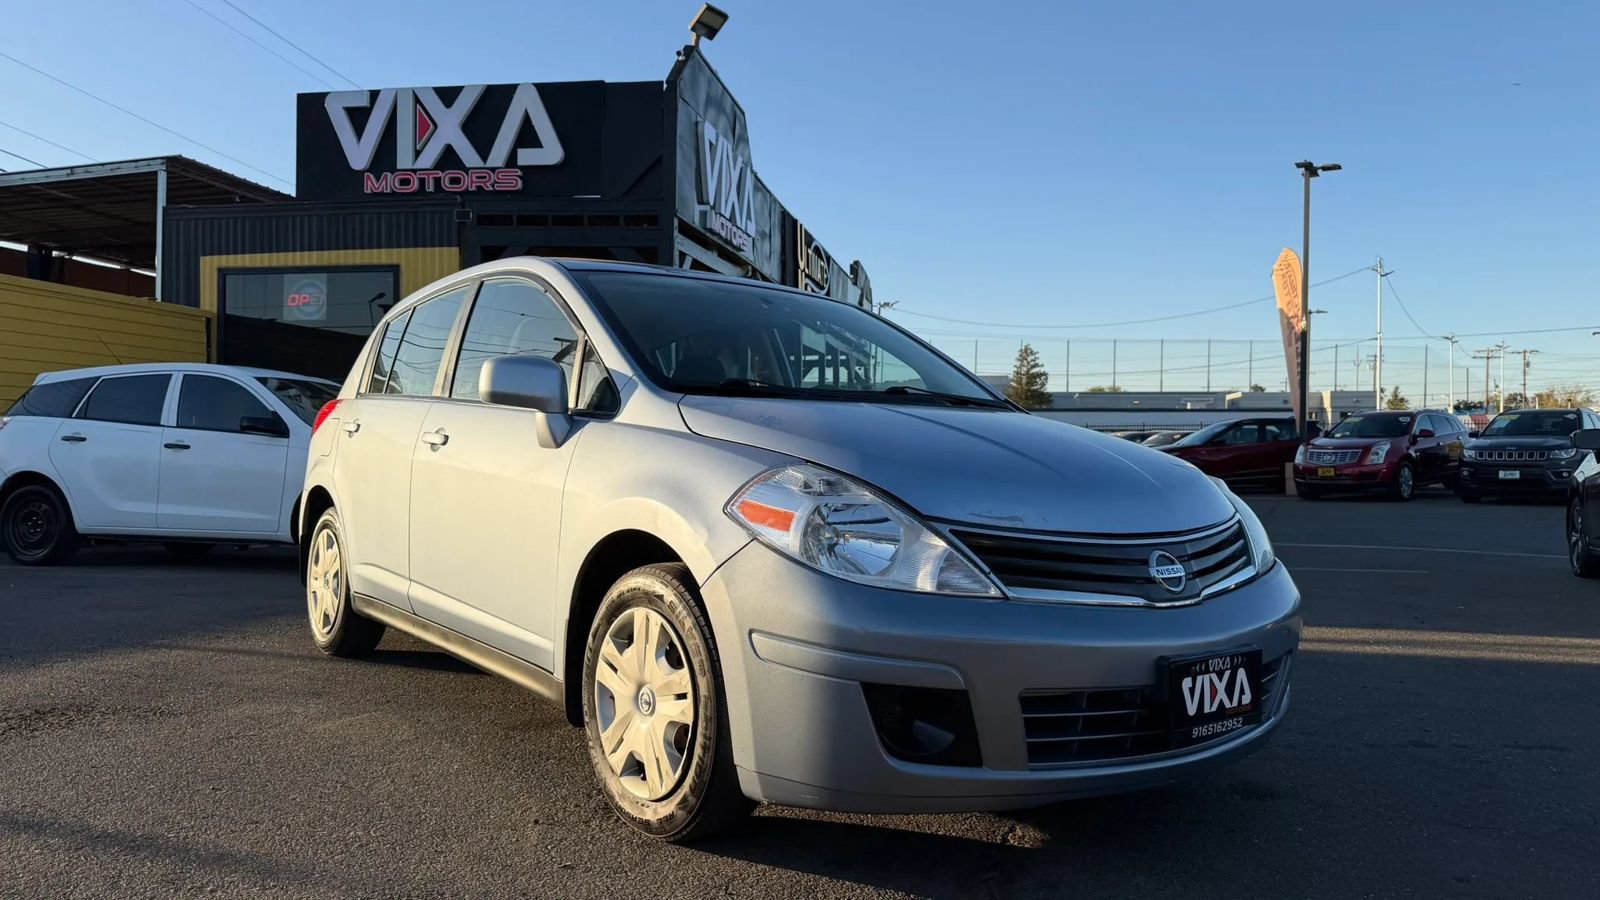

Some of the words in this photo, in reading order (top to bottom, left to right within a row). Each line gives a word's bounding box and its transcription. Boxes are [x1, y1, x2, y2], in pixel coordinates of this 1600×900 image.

[324, 82, 565, 171] VIXA
[363, 168, 523, 193] MOTORS
[703, 120, 756, 238] VIXA
[711, 209, 750, 252] MOTORS
[1155, 566, 1185, 577] NISSAN
[1208, 656, 1231, 672] VIXA
[1181, 667, 1252, 717] VIXA
[1191, 717, 1244, 739] 9165162952
